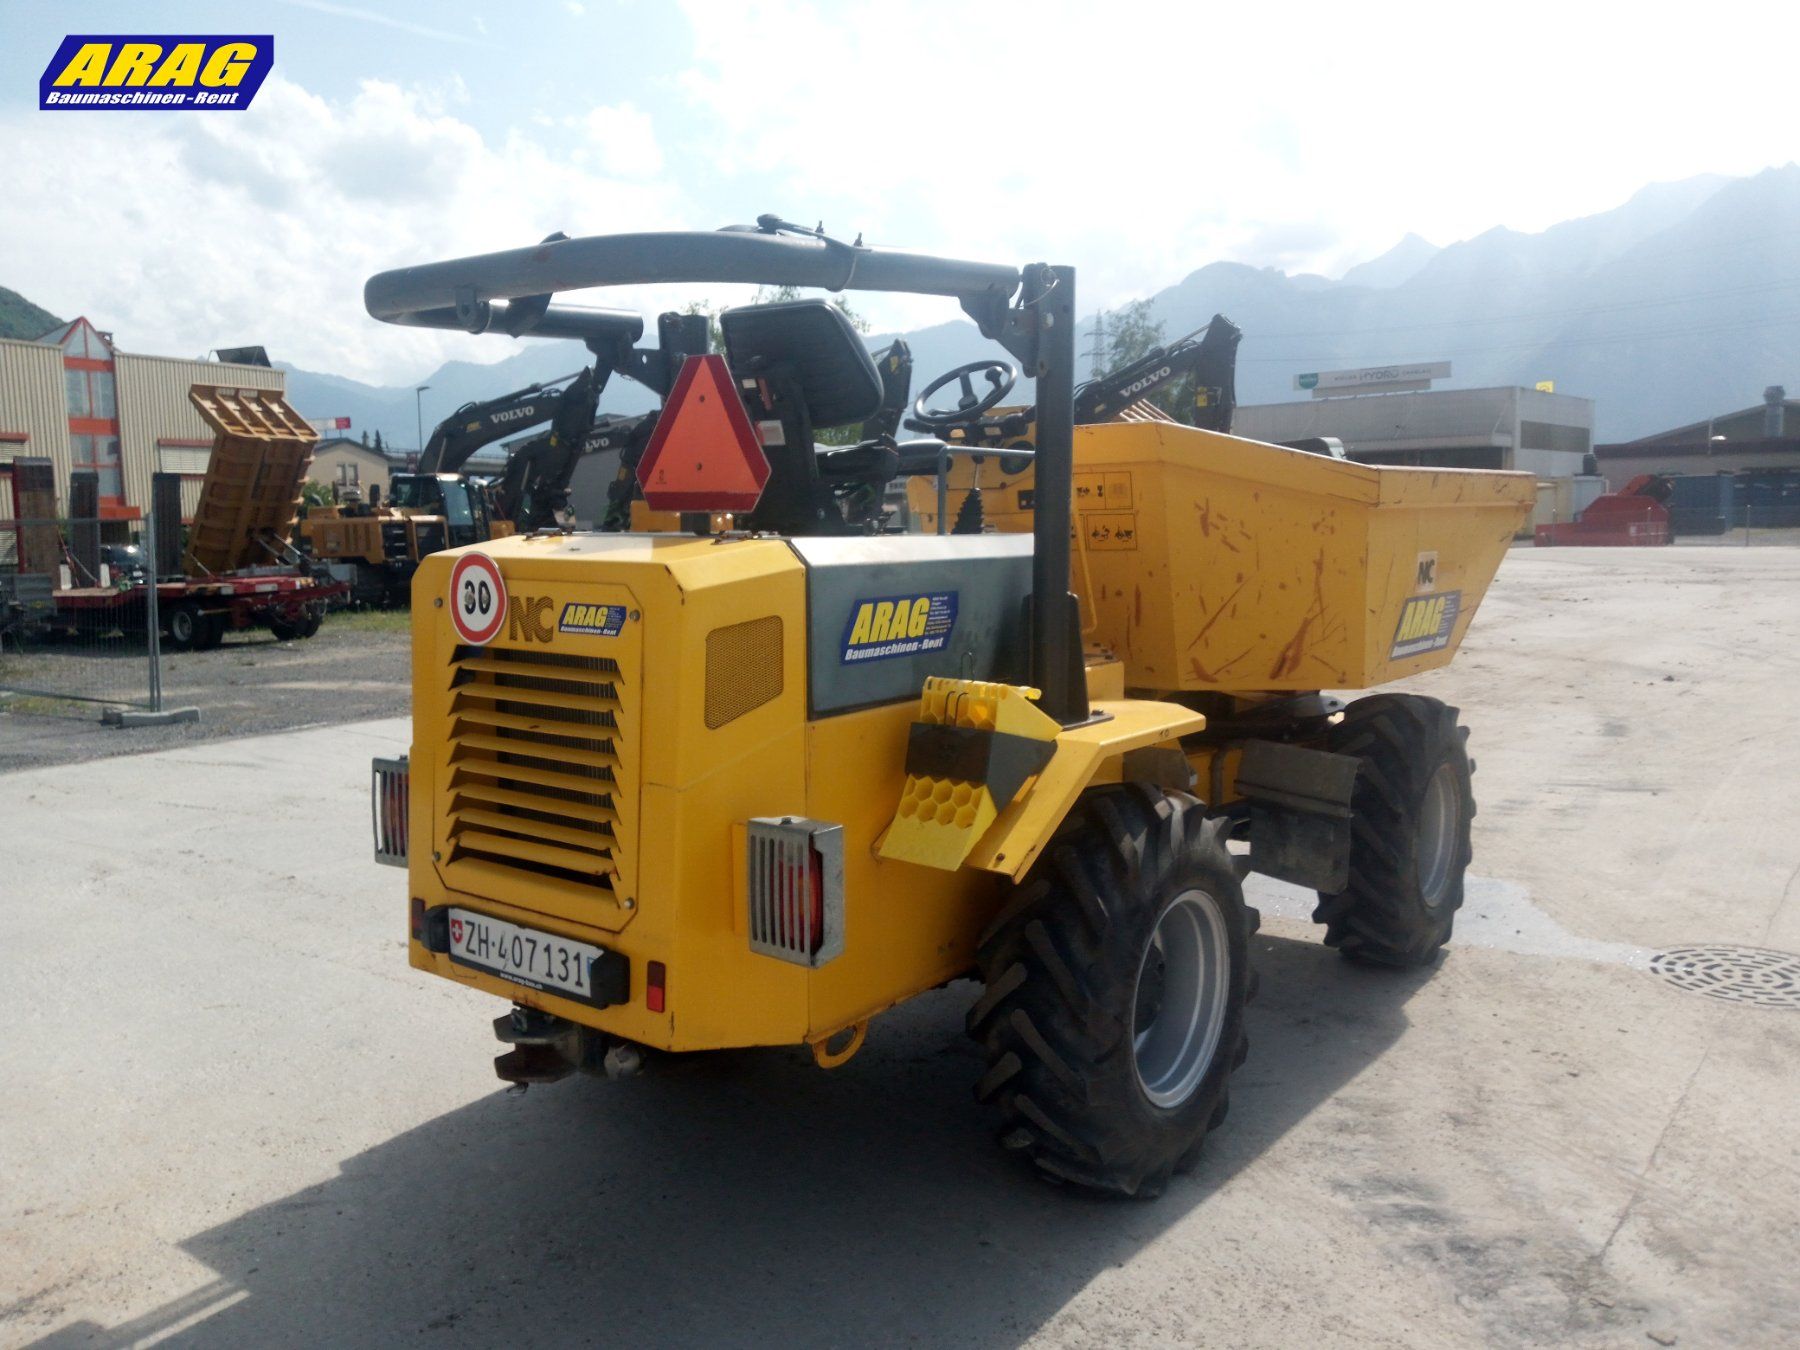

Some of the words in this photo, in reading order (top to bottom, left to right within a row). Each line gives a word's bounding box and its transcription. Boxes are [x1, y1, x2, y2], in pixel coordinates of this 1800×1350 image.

[1119, 366, 1171, 397] VOLVO
[1360, 368, 1399, 381] HYDRO
[490, 406, 534, 424] VOLVO
[584, 437, 609, 452] LVO
[464, 580, 491, 615] 30
[509, 595, 554, 643] NC
[562, 604, 609, 628] ARAG
[848, 597, 930, 645] ARAG
[1396, 596, 1446, 642] ARAG
